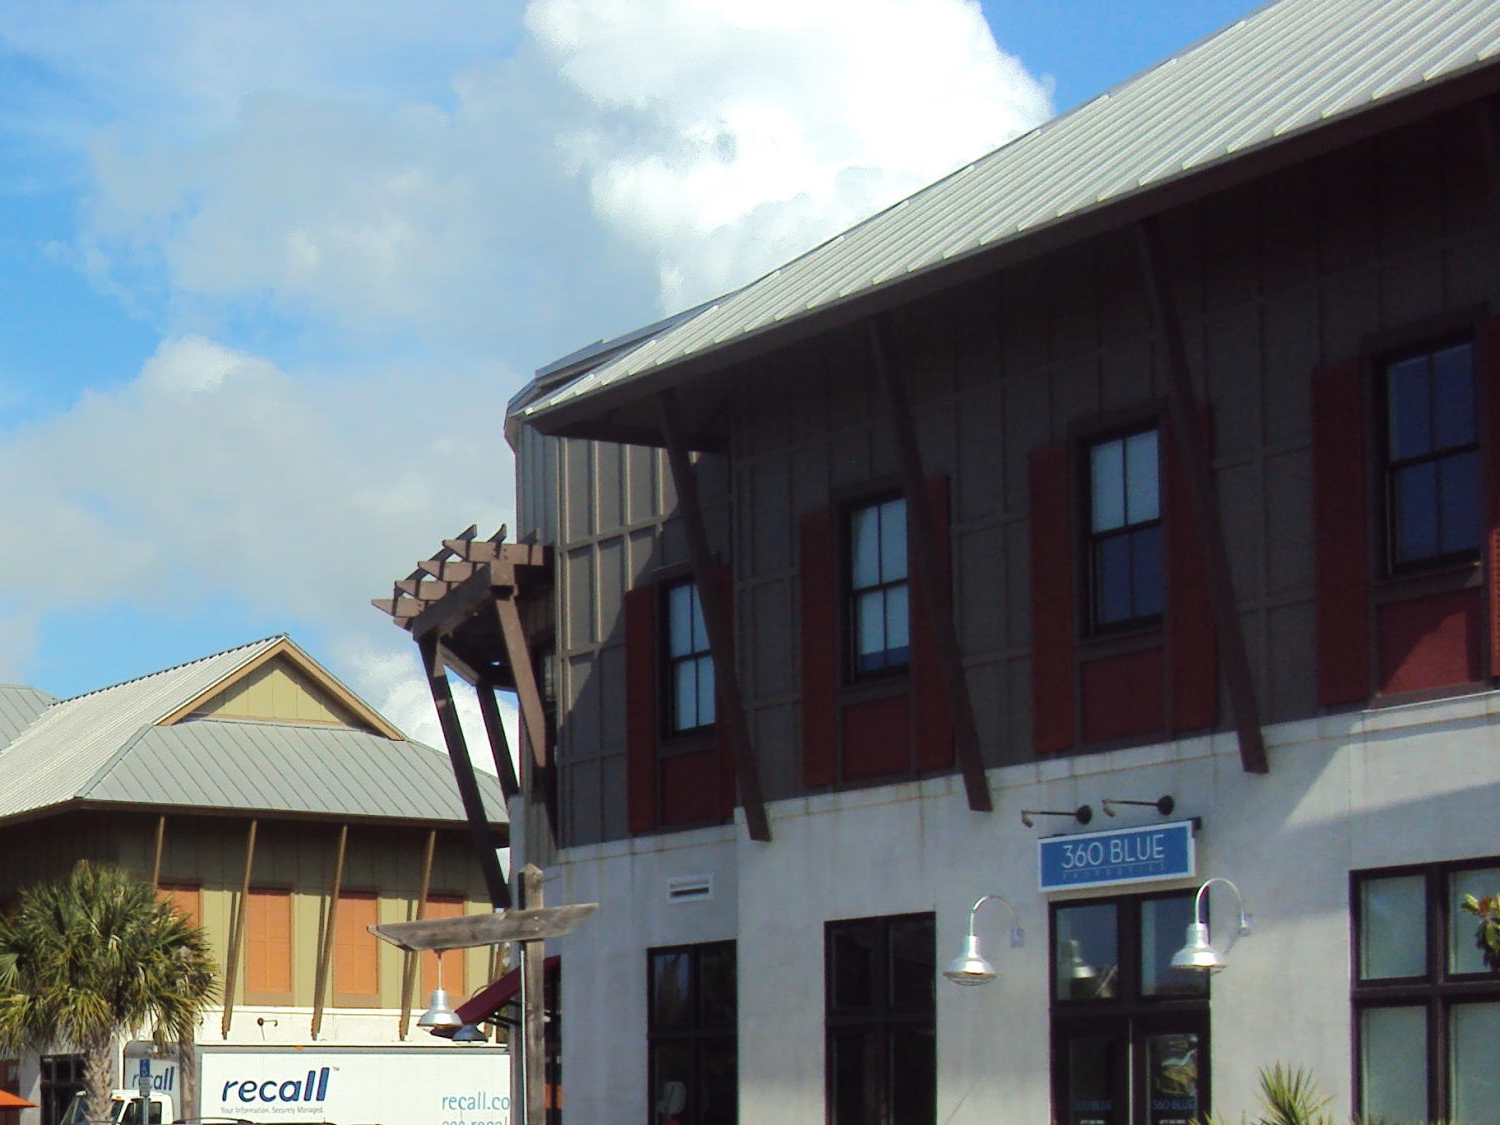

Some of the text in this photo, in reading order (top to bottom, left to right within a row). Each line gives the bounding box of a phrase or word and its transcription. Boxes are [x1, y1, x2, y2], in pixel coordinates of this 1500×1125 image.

[1061, 834, 1165, 868] 360 BLUE
[132, 1066, 175, 1091] rall
[222, 1067, 330, 1102] recall
[442, 1091, 510, 1111] recall.co
